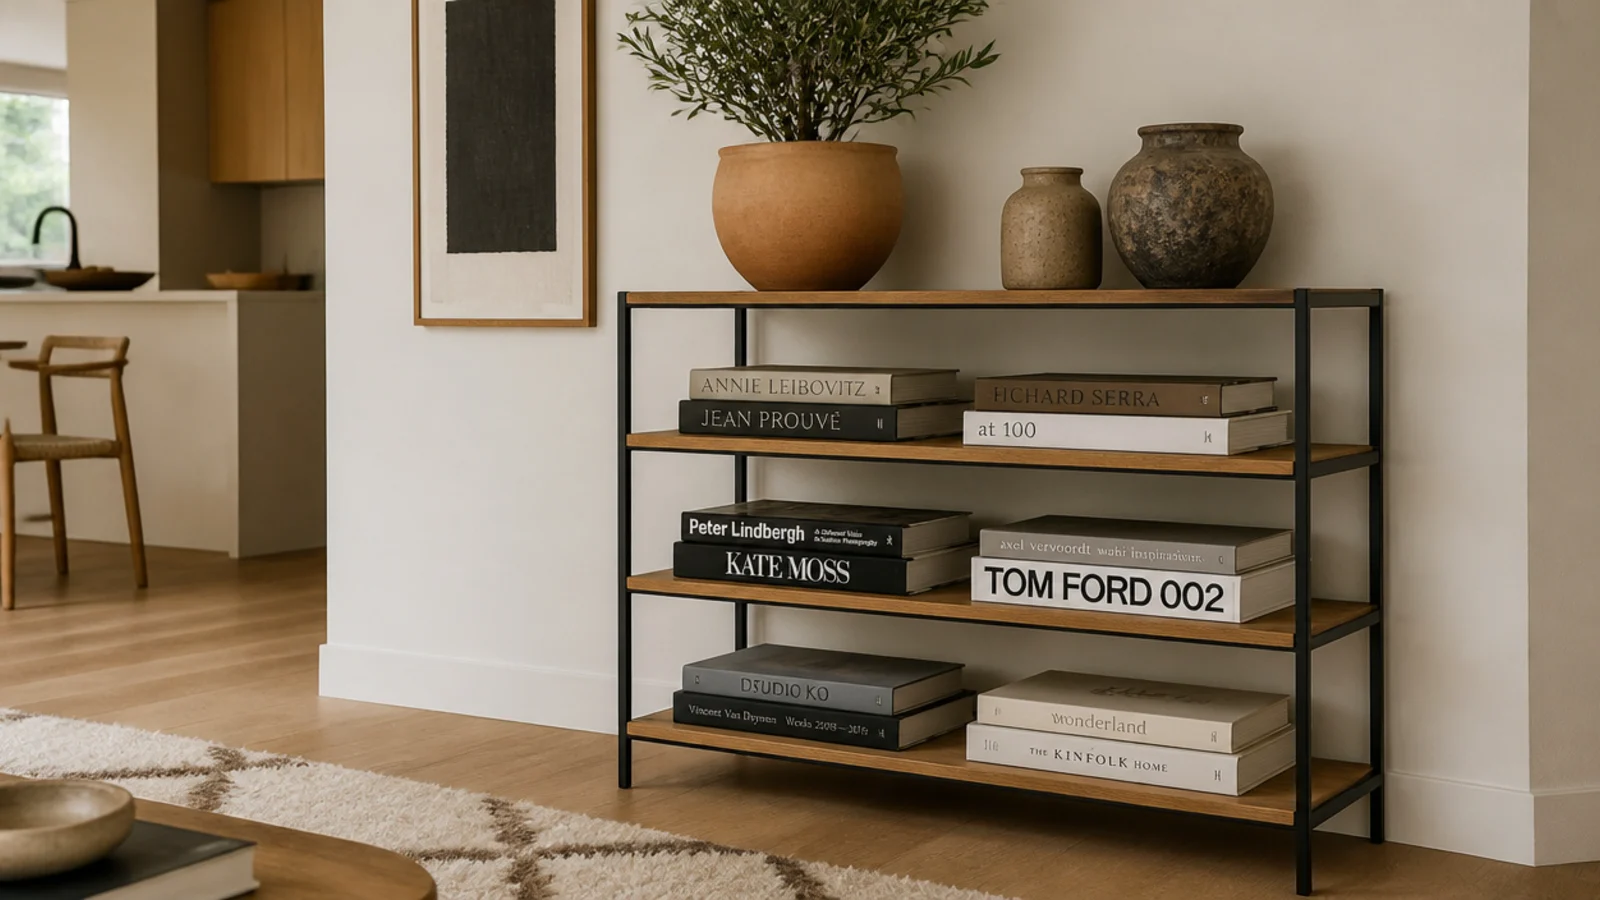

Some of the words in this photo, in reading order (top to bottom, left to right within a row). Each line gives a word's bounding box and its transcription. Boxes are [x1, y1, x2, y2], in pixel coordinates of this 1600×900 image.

[701, 378, 761, 394] ANNIE
[769, 379, 866, 397] LEIBOVITZ
[1092, 389, 1160, 407] SERRA
[701, 409, 751, 428] JEAN
[759, 411, 841, 431] PROUVÉ
[978, 421, 996, 437] at
[1003, 421, 1037, 438] 100
[689, 518, 728, 536] Peter
[731, 521, 805, 544] Lindbergh
[1000, 539, 1024, 551] axel
[1030, 542, 1091, 555] vervoordt
[725, 551, 783, 579] KATE
[787, 556, 850, 584] MOSS
[984, 566, 1053, 599] TOM
[1063, 571, 1153, 606] FORD
[1160, 579, 1224, 613] 002
[806, 684, 829, 702] KO
[1030, 747, 1048, 756] THE
[1054, 748, 1128, 768] KINFOLK
[1134, 760, 1168, 773] HOME
